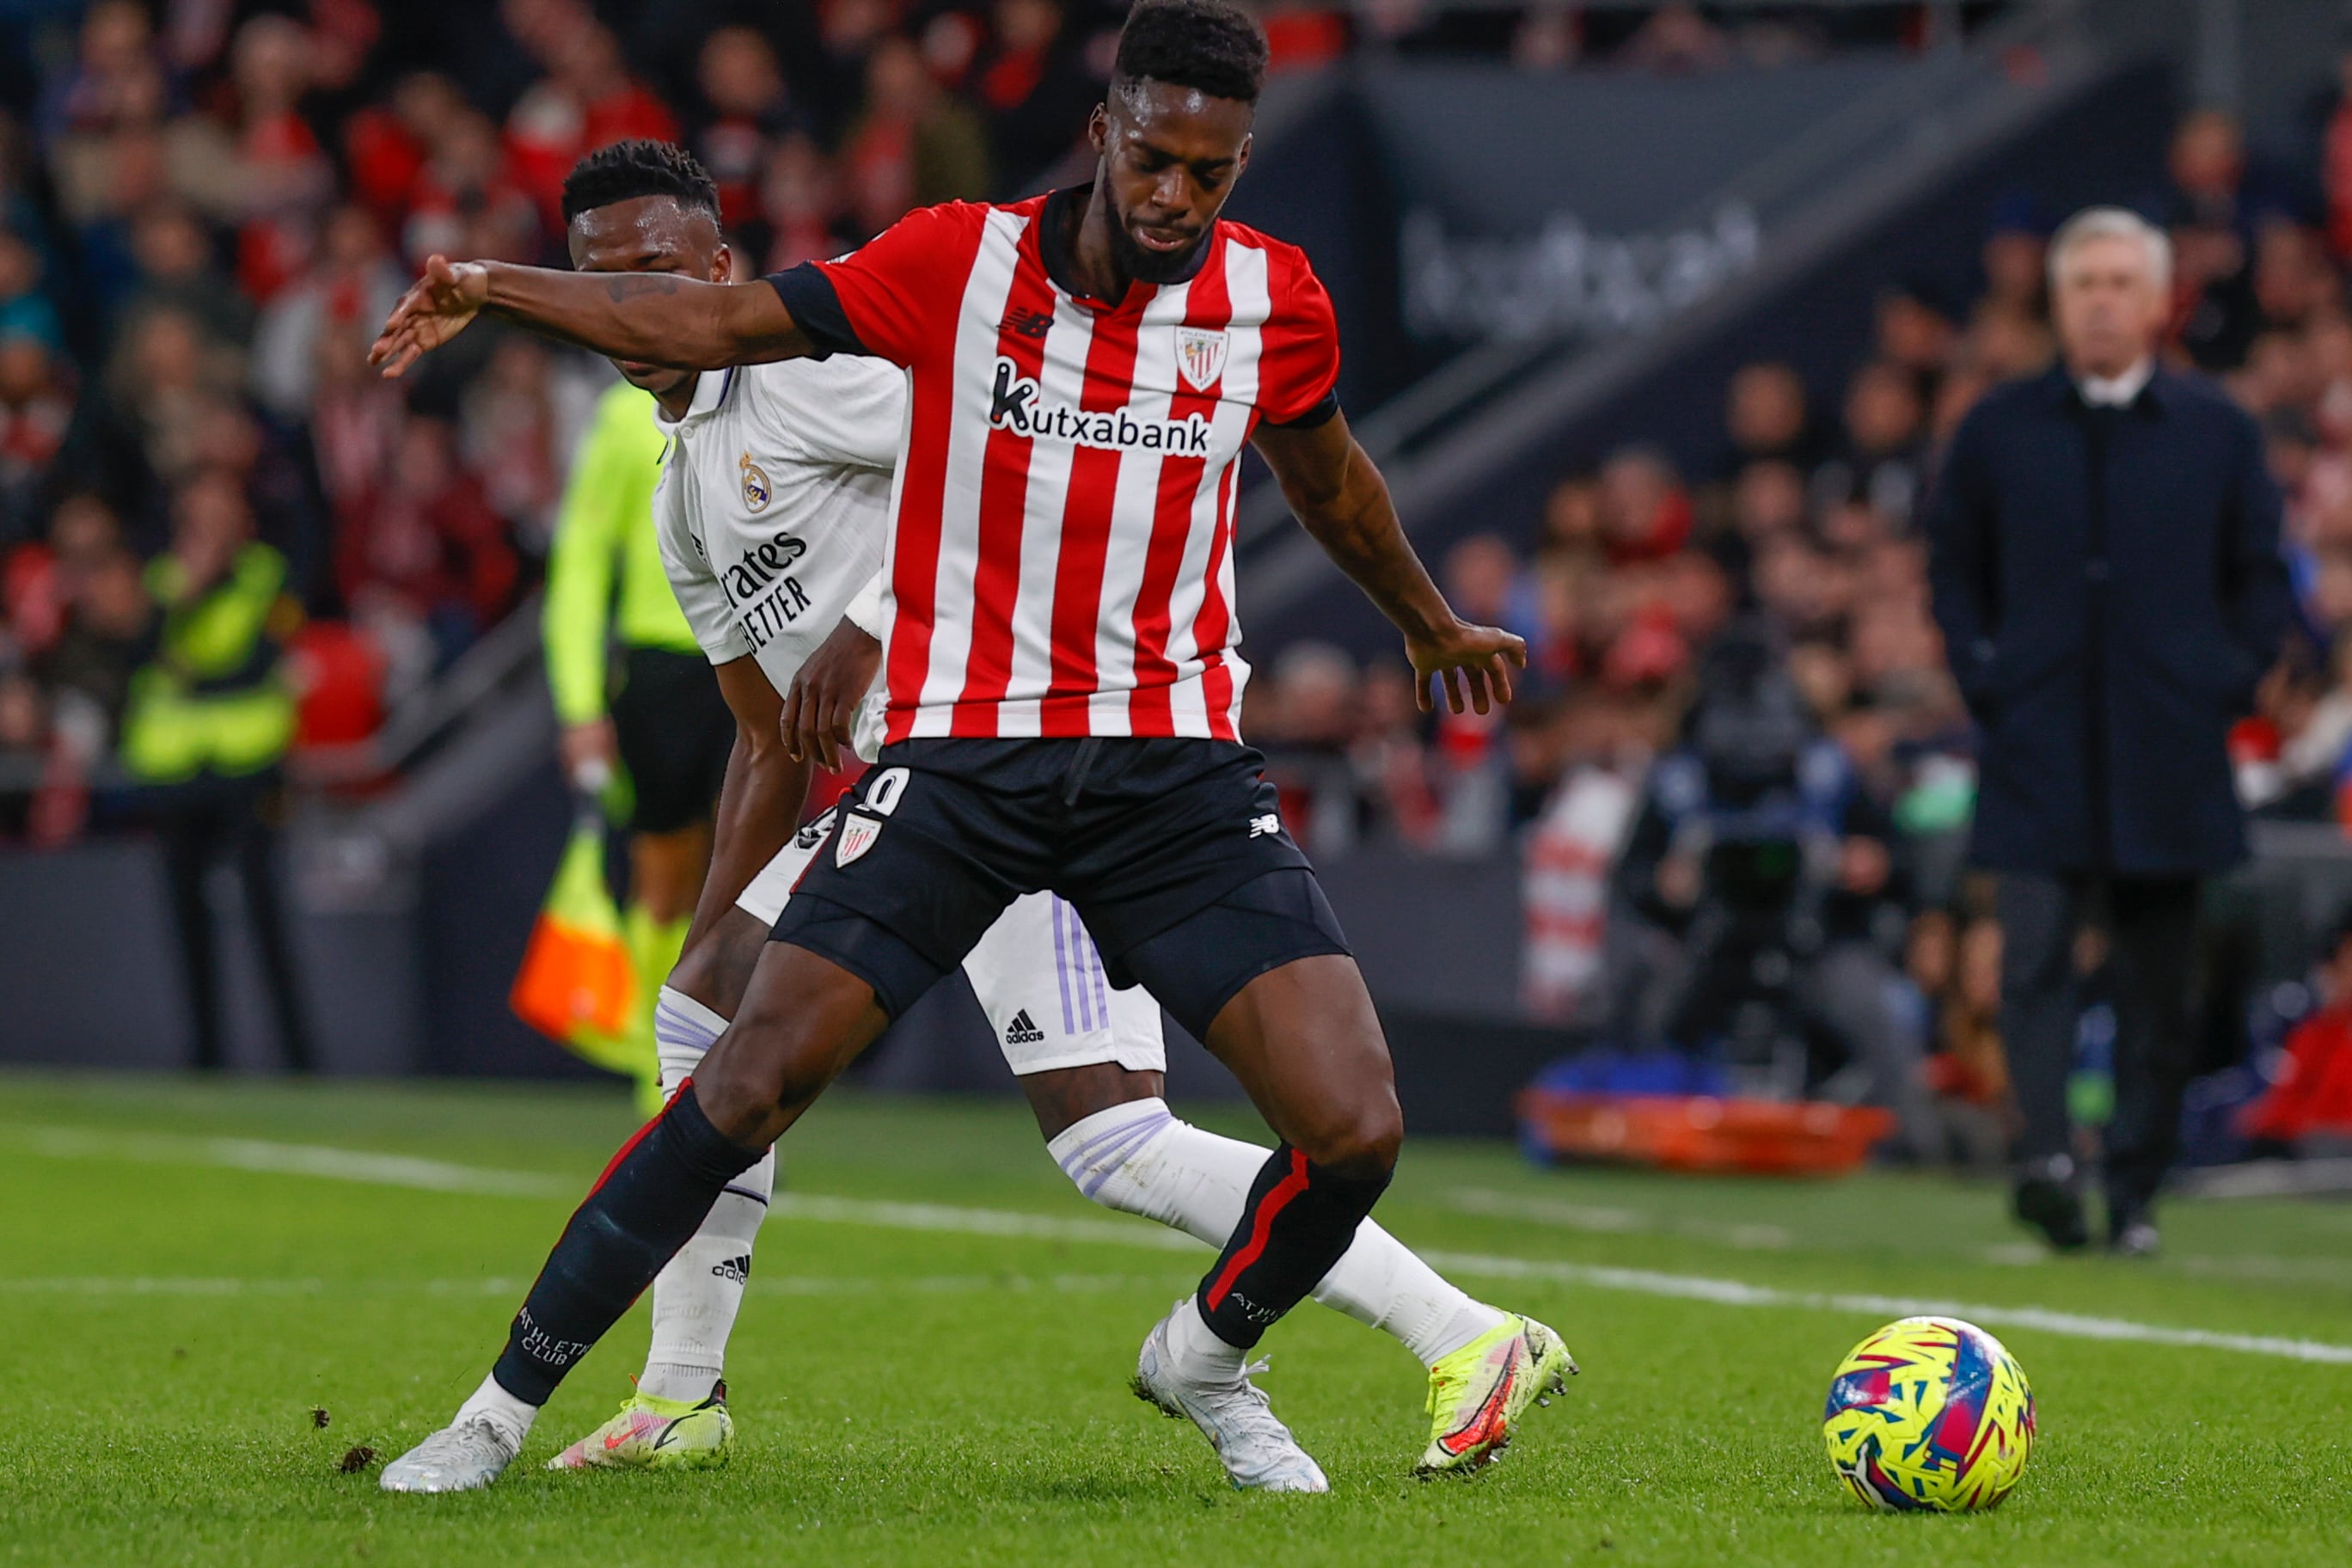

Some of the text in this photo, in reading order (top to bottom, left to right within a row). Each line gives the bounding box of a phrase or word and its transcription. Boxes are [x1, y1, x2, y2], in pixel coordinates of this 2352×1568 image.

[990, 363, 1208, 451] Kutxabank
[738, 576, 812, 656] BETTER
[1006, 1031, 1045, 1044] adidas
[521, 1336, 568, 1366] CLUB
